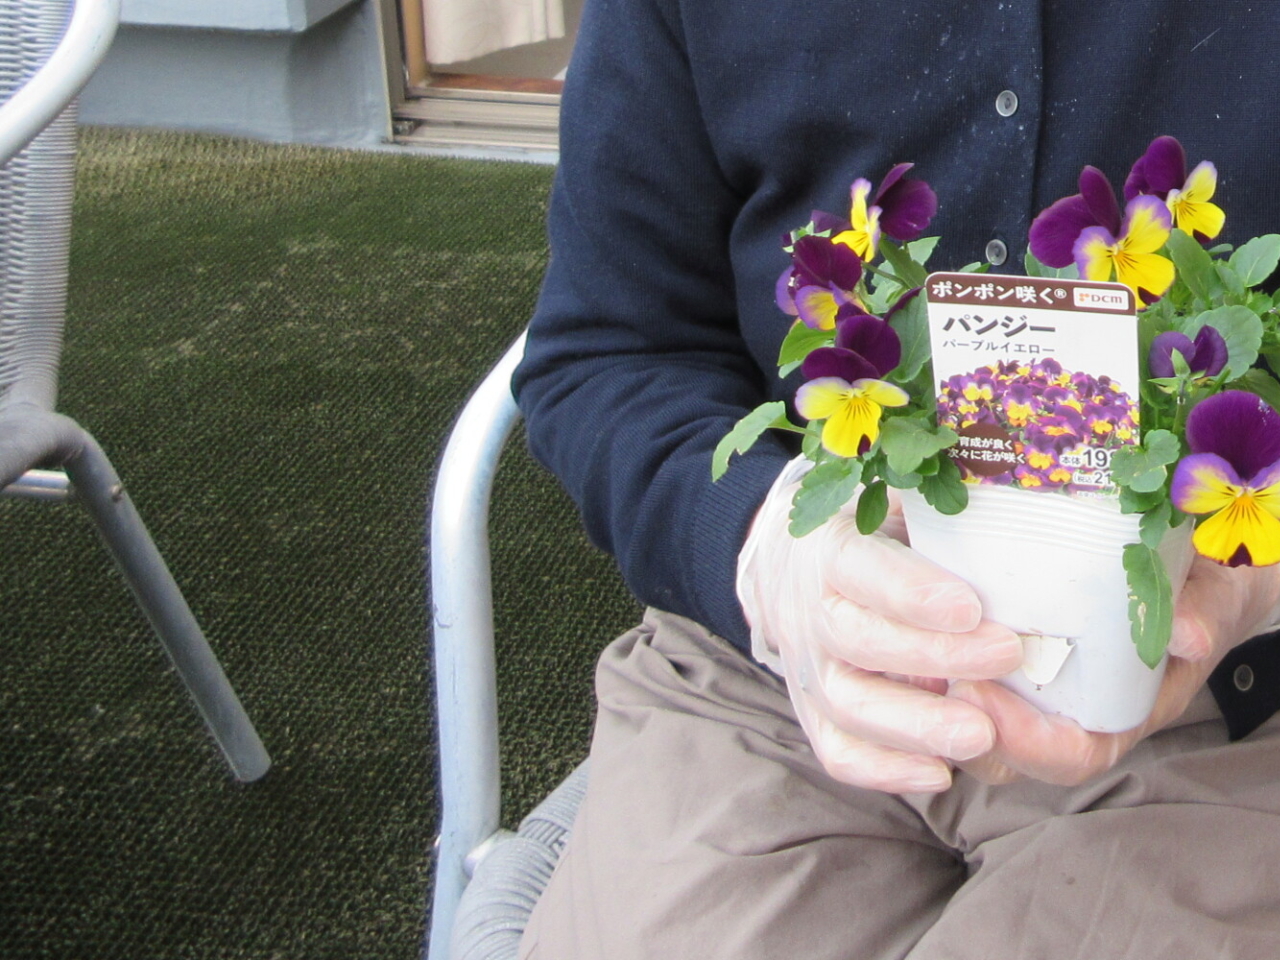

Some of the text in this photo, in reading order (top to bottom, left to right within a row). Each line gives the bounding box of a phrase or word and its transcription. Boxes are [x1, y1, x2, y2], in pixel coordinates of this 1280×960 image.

[943, 315, 1056, 338] パンジー
[943, 339, 1055, 355] パープルイエロー
[959, 436, 1013, 450] 育成が良く
[948, 448, 1025, 464] 次々に花が咲く
